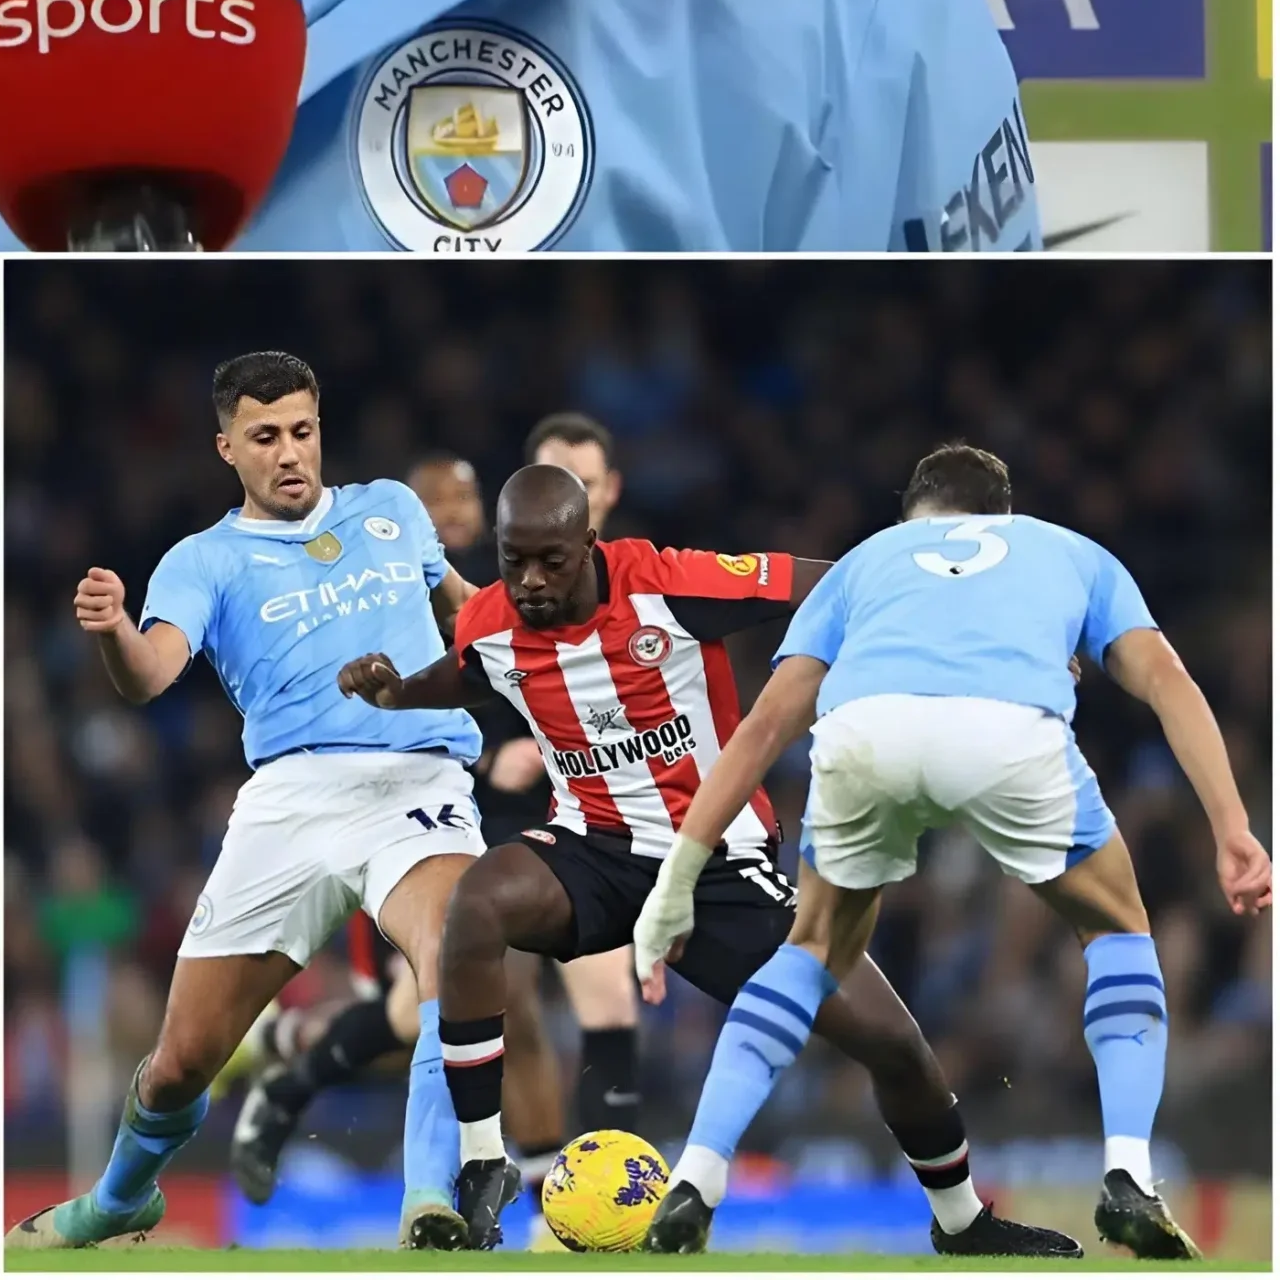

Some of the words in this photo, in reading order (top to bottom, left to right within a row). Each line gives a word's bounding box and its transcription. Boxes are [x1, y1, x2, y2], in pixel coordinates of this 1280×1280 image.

[373, 37, 565, 119] MANCHESTER
[433, 235, 503, 252] CITY
[911, 516, 1011, 578] 3
[260, 561, 418, 623] ETIHAD
[552, 713, 693, 777] HOLLYWOOD
